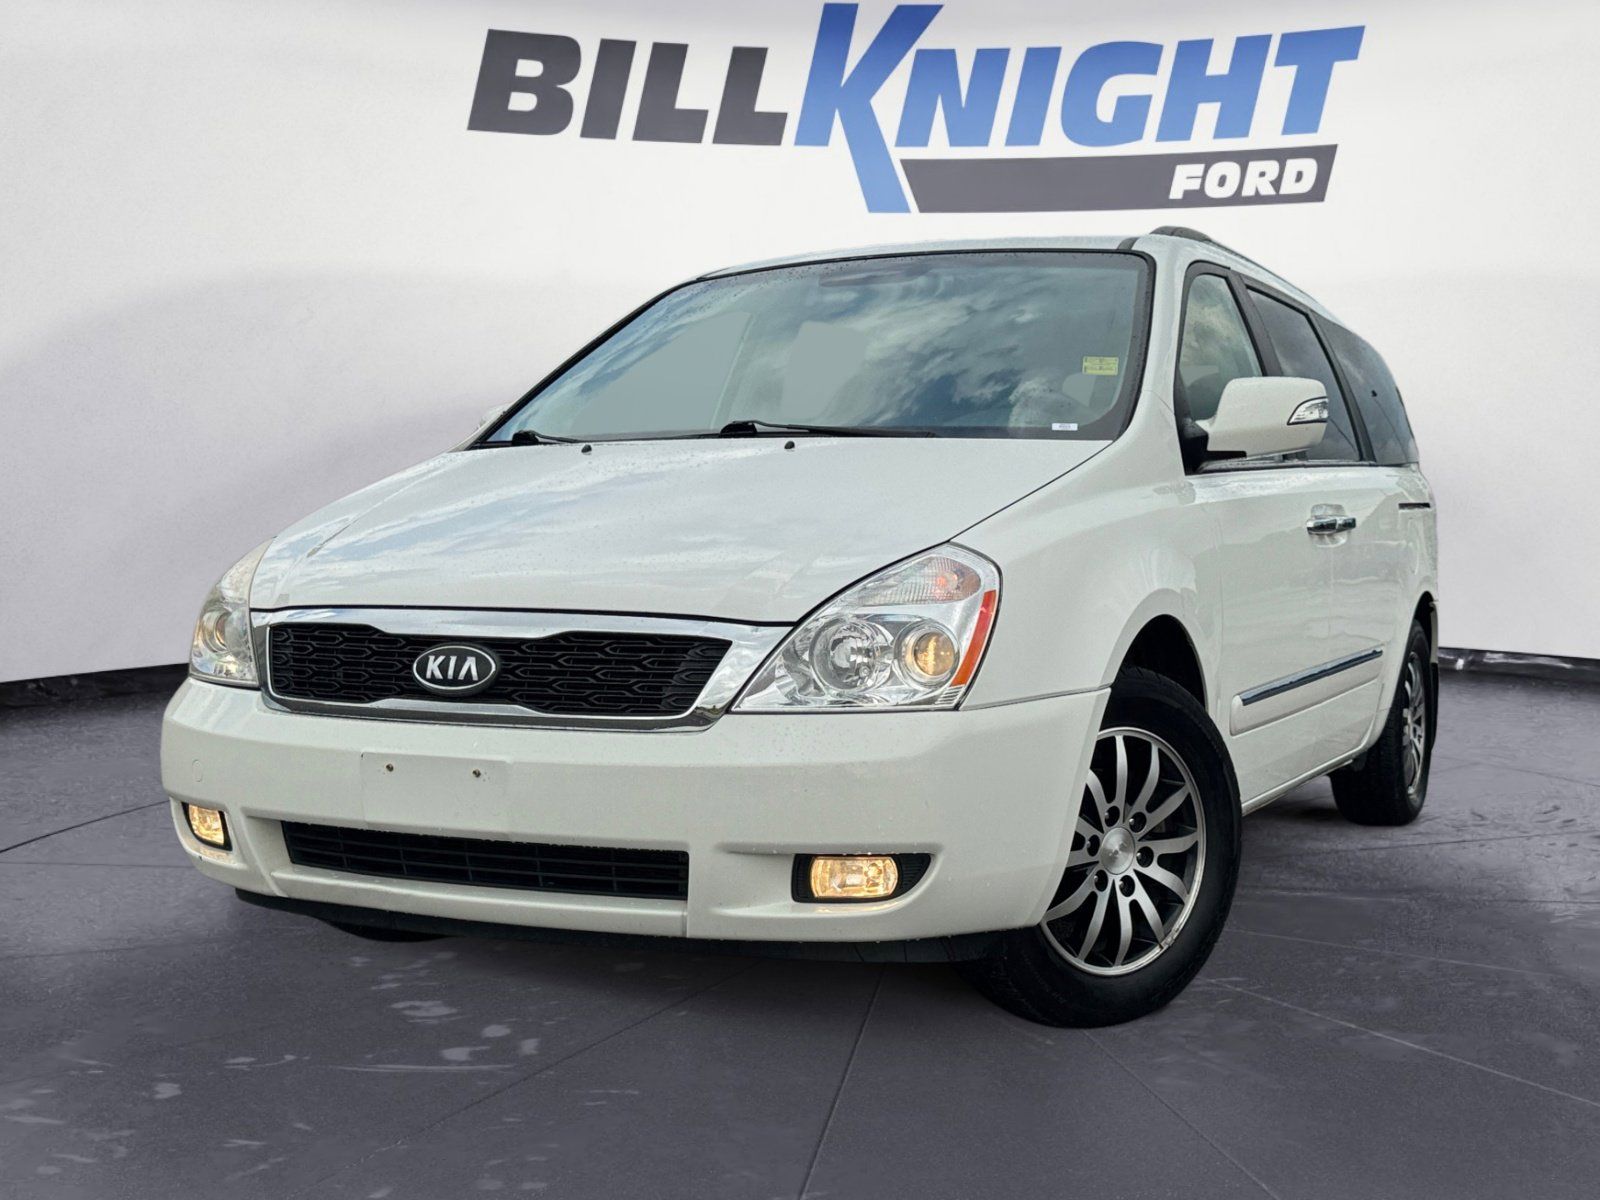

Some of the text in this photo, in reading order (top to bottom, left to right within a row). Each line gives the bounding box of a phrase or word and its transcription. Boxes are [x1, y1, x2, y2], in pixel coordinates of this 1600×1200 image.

[467, 2, 1365, 213] BILL KNIGHT
[1169, 158, 1318, 199] FORD
[426, 655, 479, 681] KIA
